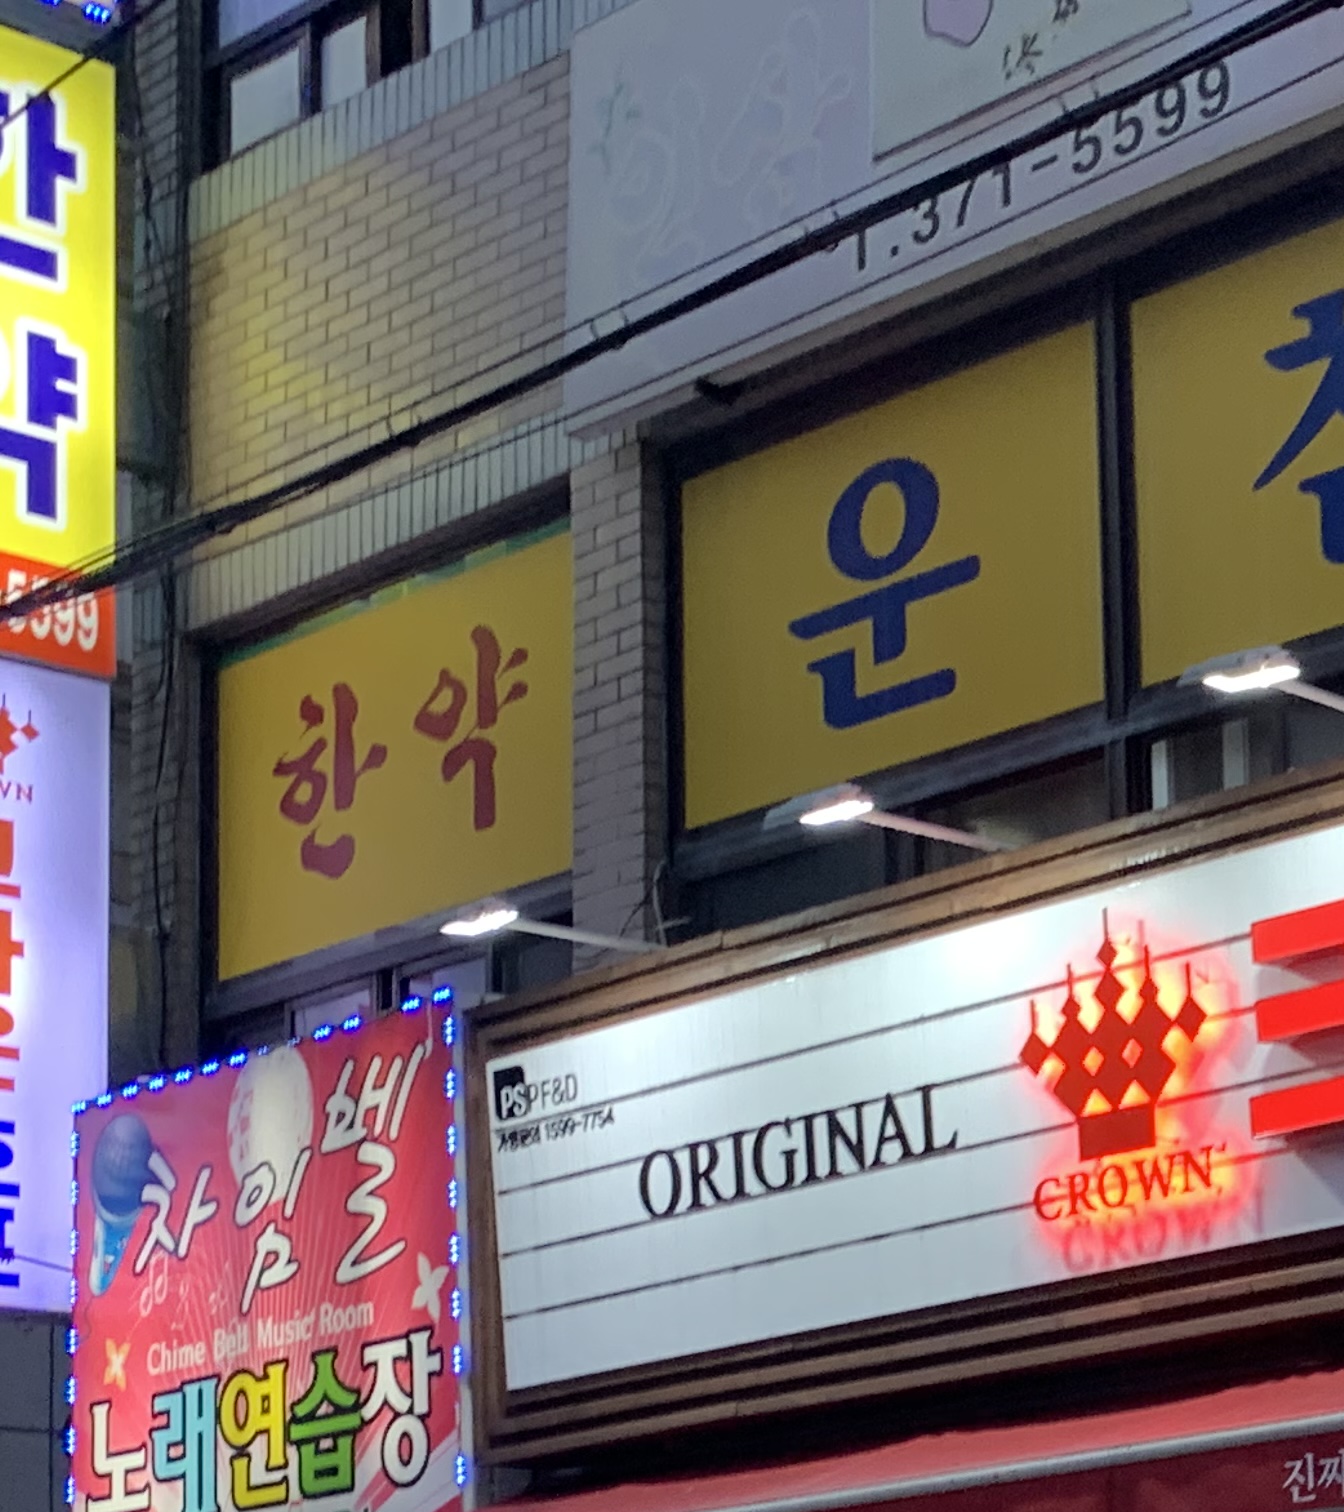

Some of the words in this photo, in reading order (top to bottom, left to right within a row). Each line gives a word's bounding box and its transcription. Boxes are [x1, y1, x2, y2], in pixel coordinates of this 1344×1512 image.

[787, 457, 981, 733] 운
[272, 624, 528, 879] 한약
[638, 1084, 958, 1220] ORIGINAL
[1033, 1144, 1218, 1224] CROWN
[146, 1335, 207, 1376] Chime
[257, 1313, 315, 1354] Music
[319, 1300, 374, 1337] Room
